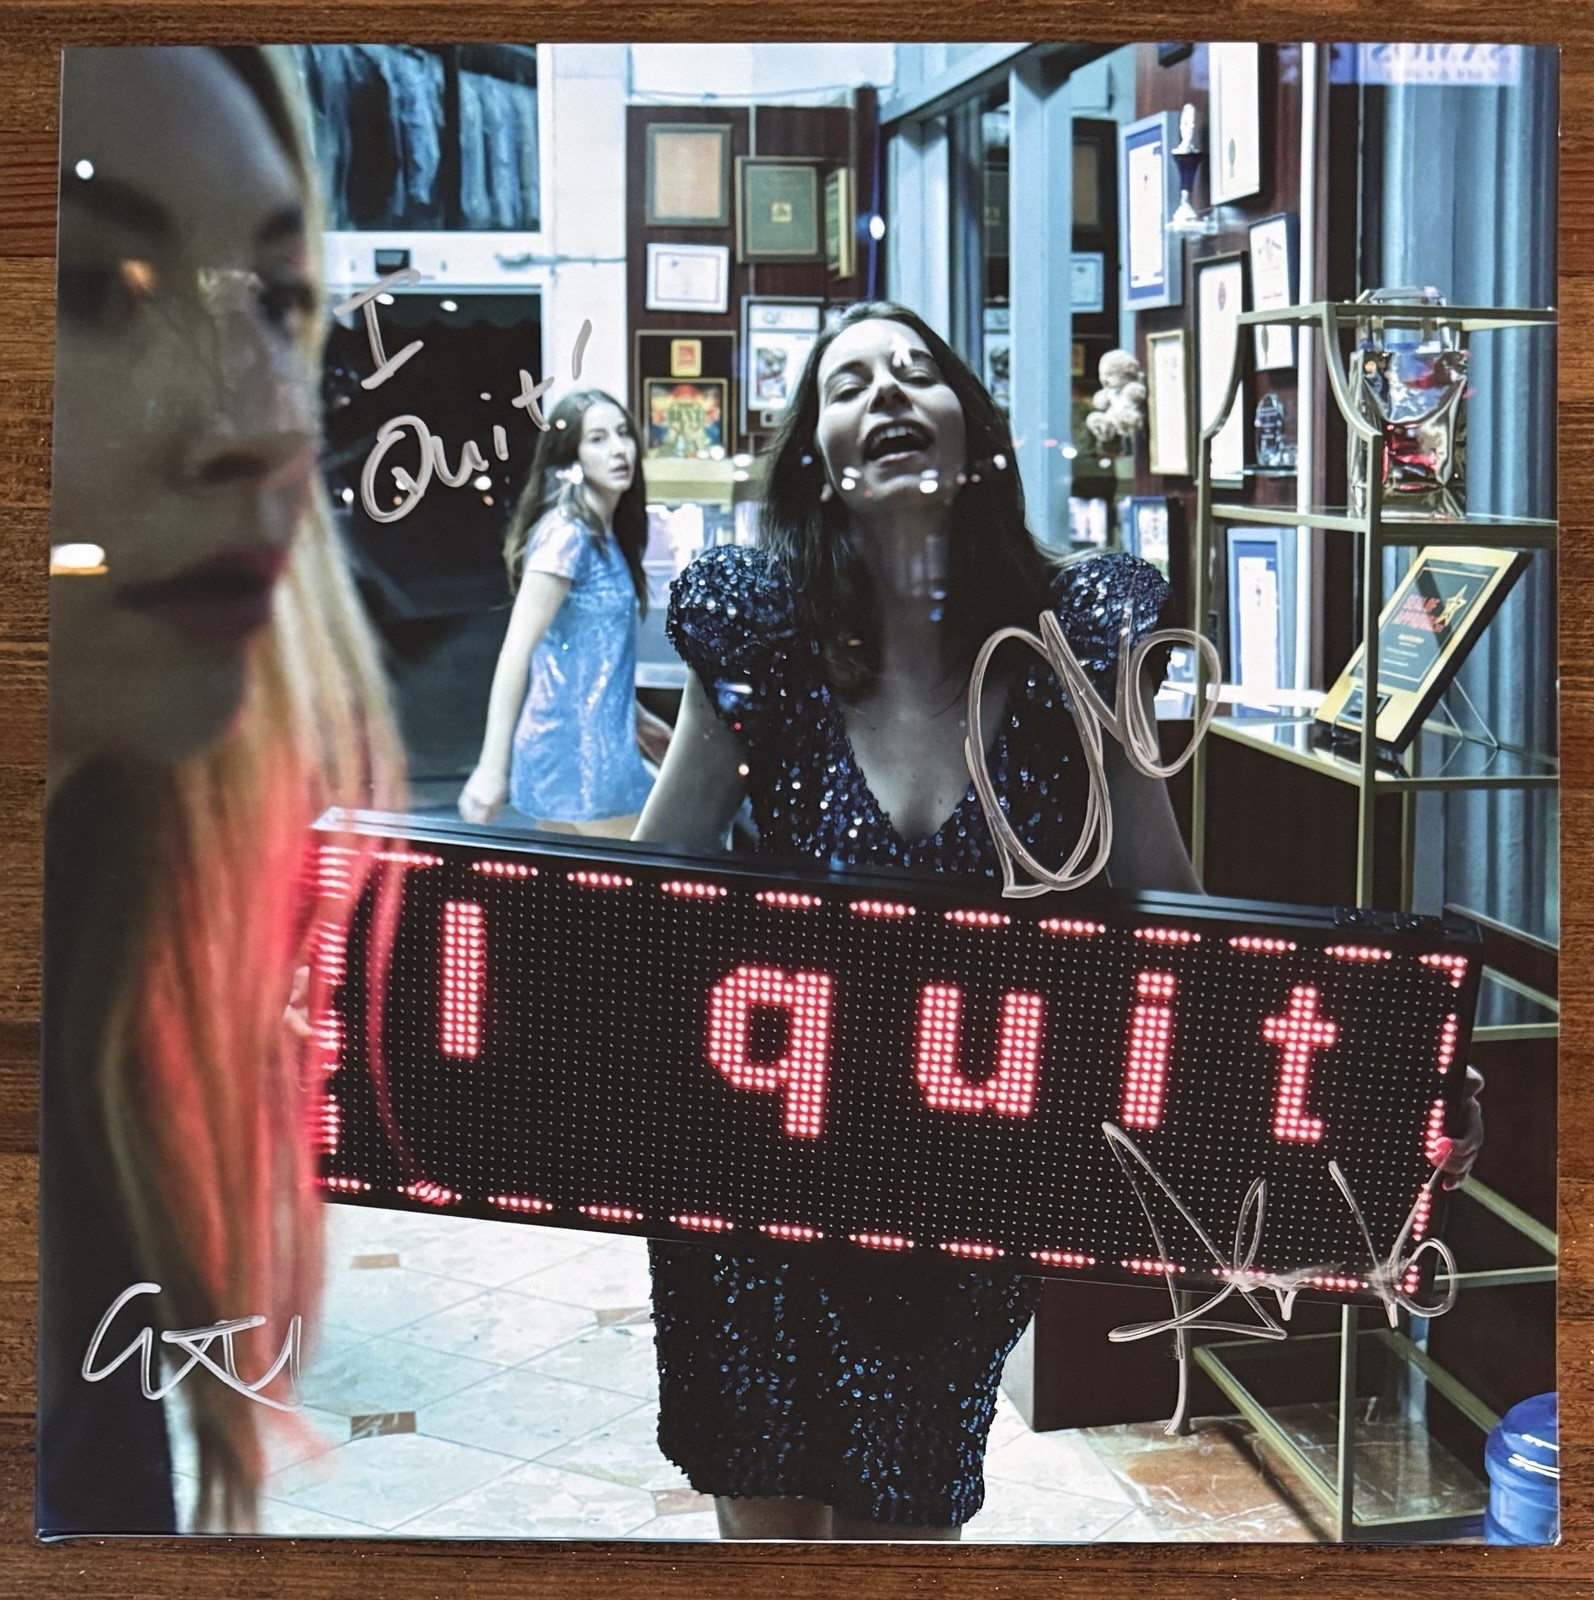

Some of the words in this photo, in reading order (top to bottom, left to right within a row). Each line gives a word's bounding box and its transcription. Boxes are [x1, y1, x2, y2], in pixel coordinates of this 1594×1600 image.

[332, 268, 424, 391] I
[440, 900, 487, 1060] I
[706, 964, 1338, 1145] quit
